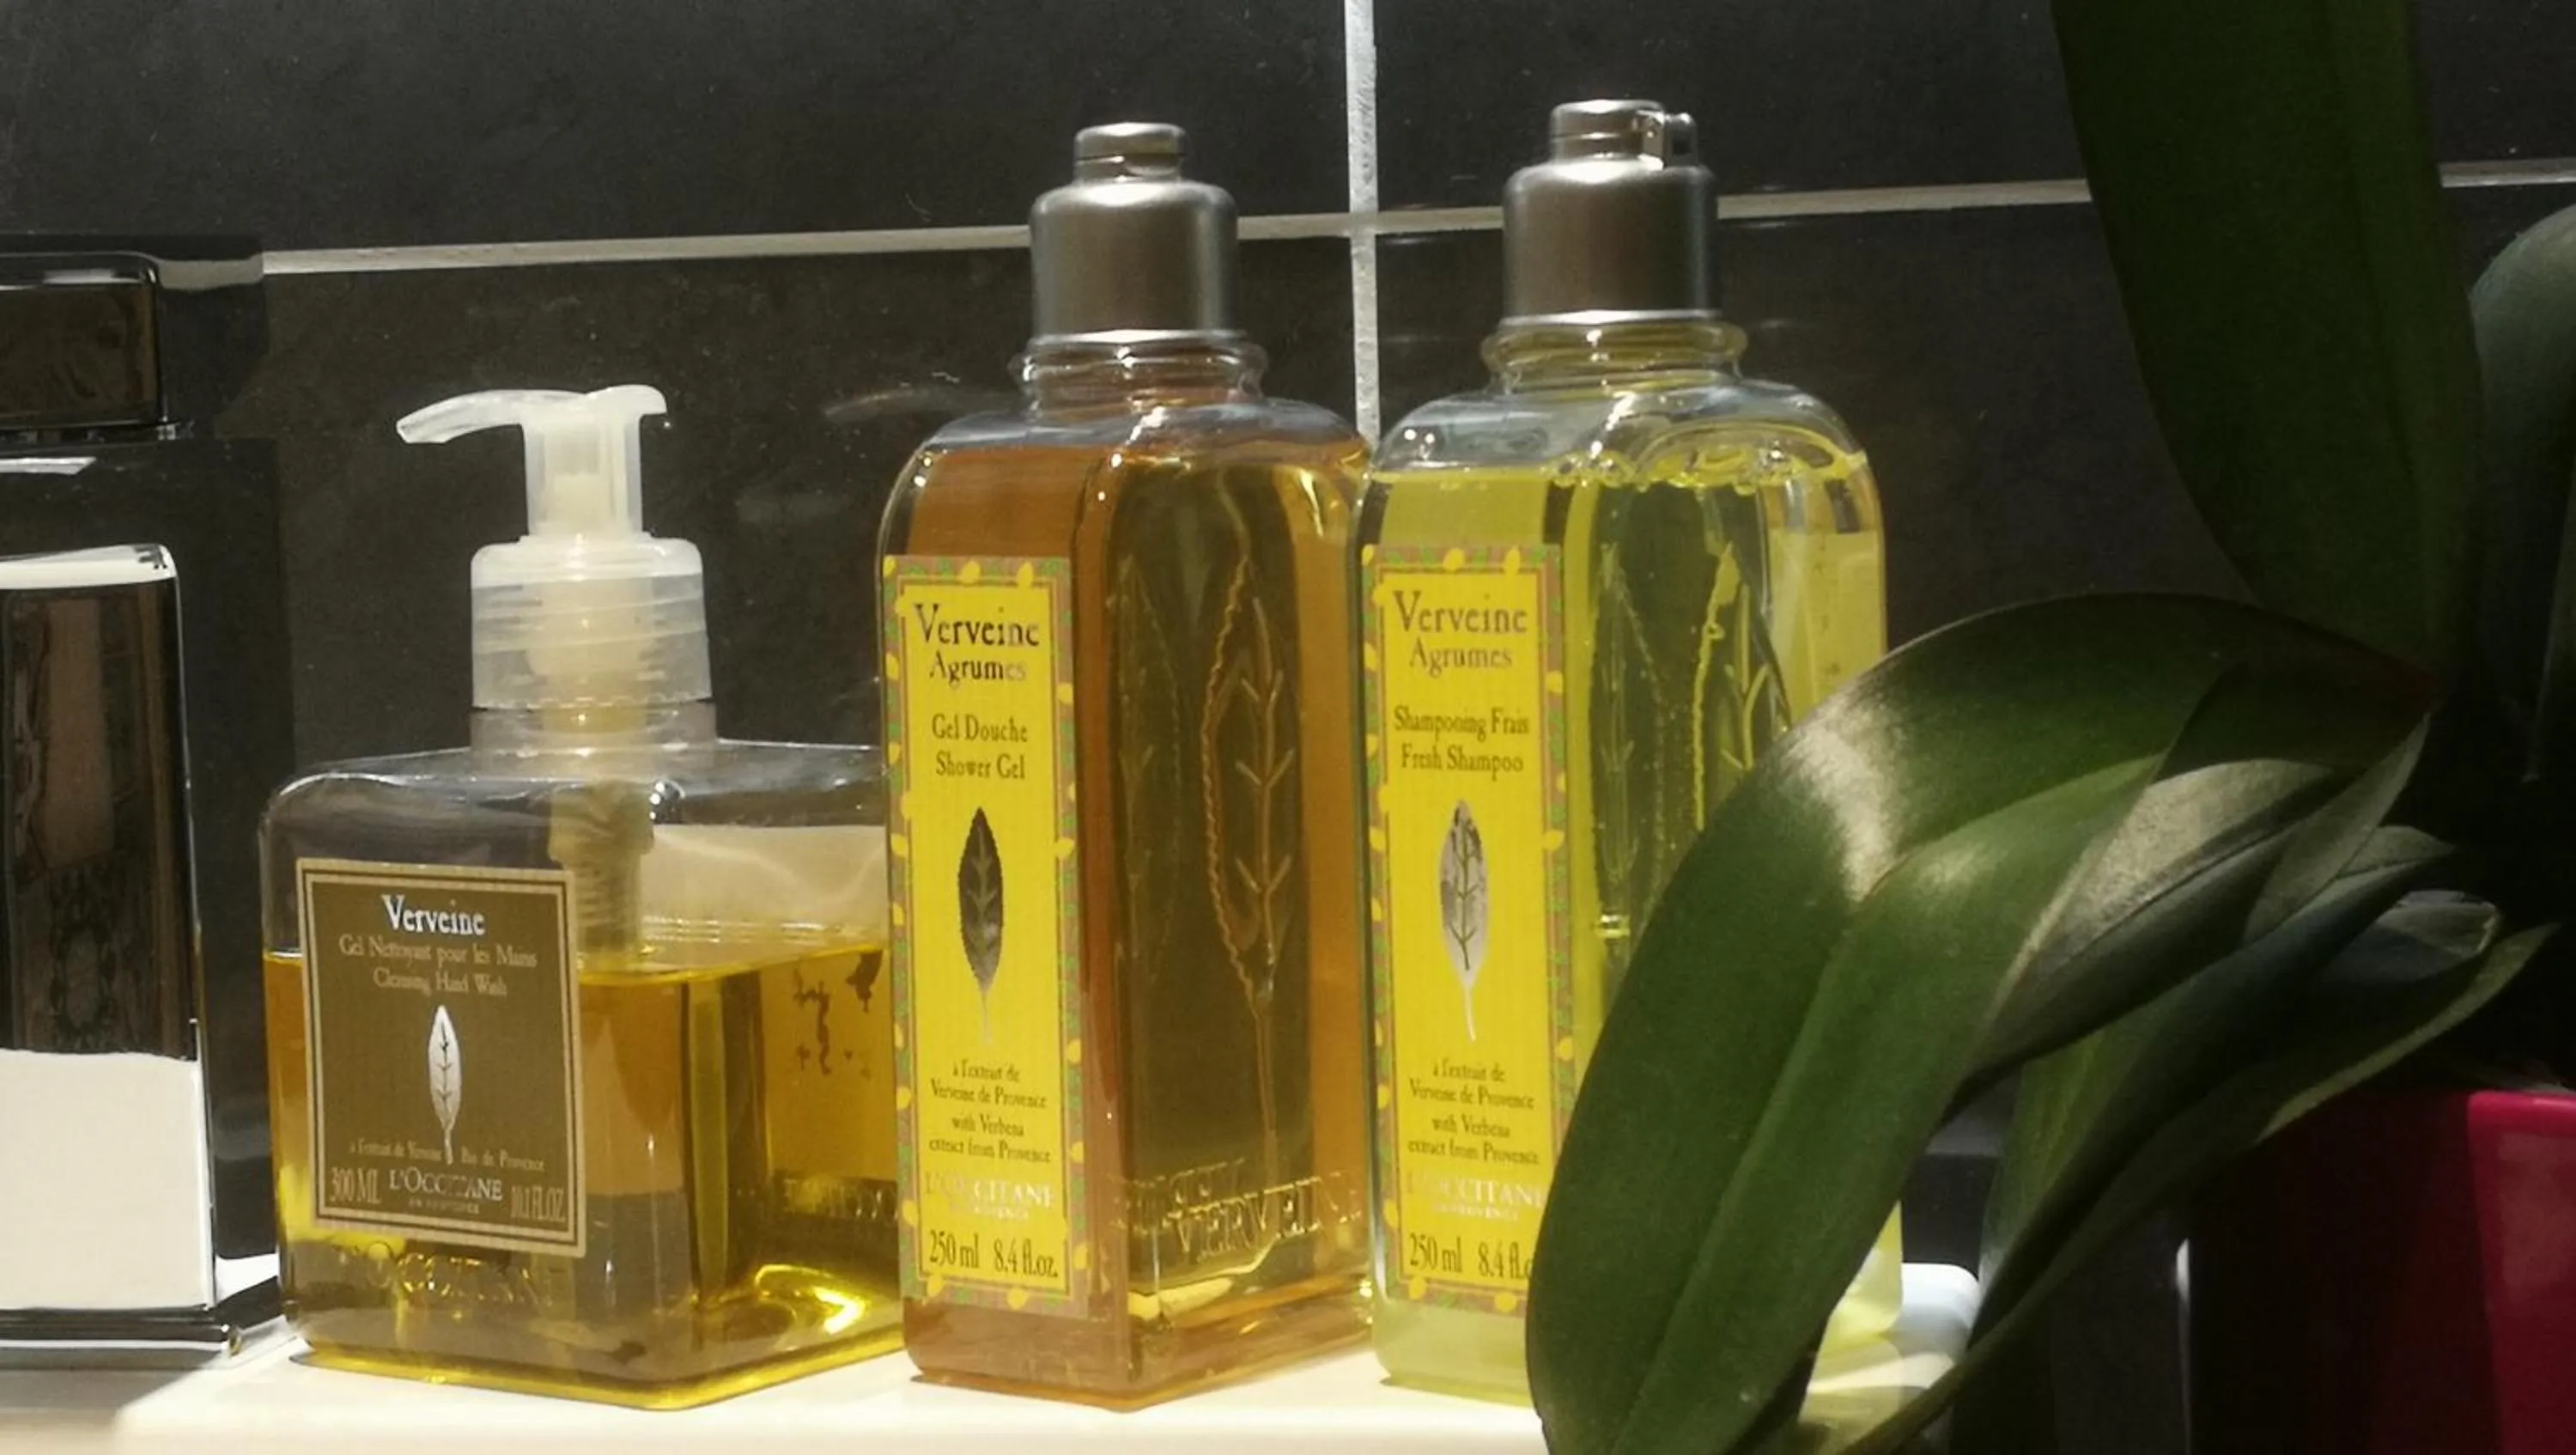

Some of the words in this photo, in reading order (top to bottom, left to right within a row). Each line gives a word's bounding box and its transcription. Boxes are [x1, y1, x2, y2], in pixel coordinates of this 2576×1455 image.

[914, 602, 1040, 648] Verveine
[1393, 589, 1528, 633] Verveine
[929, 649, 1027, 689] Agrumes
[1409, 636, 1514, 679] Agrumes
[932, 713, 959, 740] Gel
[964, 714, 1029, 744] Douche
[1394, 704, 1486, 743] Shampooing
[1491, 706, 1530, 735] Frais
[936, 750, 992, 780] Shower
[996, 752, 1026, 781] Gel
[1401, 742, 1442, 770] Fresh
[1446, 744, 1524, 782] Shampoo
[380, 893, 486, 935] Verveine
[339, 934, 365, 956] Gel
[436, 946, 468, 969] pour
[472, 943, 490, 965] les
[435, 970, 469, 994] Hand
[978, 1085, 992, 1103] de
[994, 1086, 1048, 1109] Provence
[1460, 1086, 1475, 1105] de
[1478, 1086, 1535, 1111] Provence
[980, 1113, 1024, 1138] Verbena
[999, 1140, 1052, 1163] Provence
[1483, 1141, 1540, 1166] Provence
[331, 1166, 355, 1202] 300
[929, 1229, 957, 1268] 250
[959, 1233, 981, 1269] ml
[992, 1238, 1018, 1274] 8.4
[1409, 1232, 1439, 1271] 250
[1442, 1236, 1463, 1273] ml
[1477, 1241, 1504, 1278] 8.4
